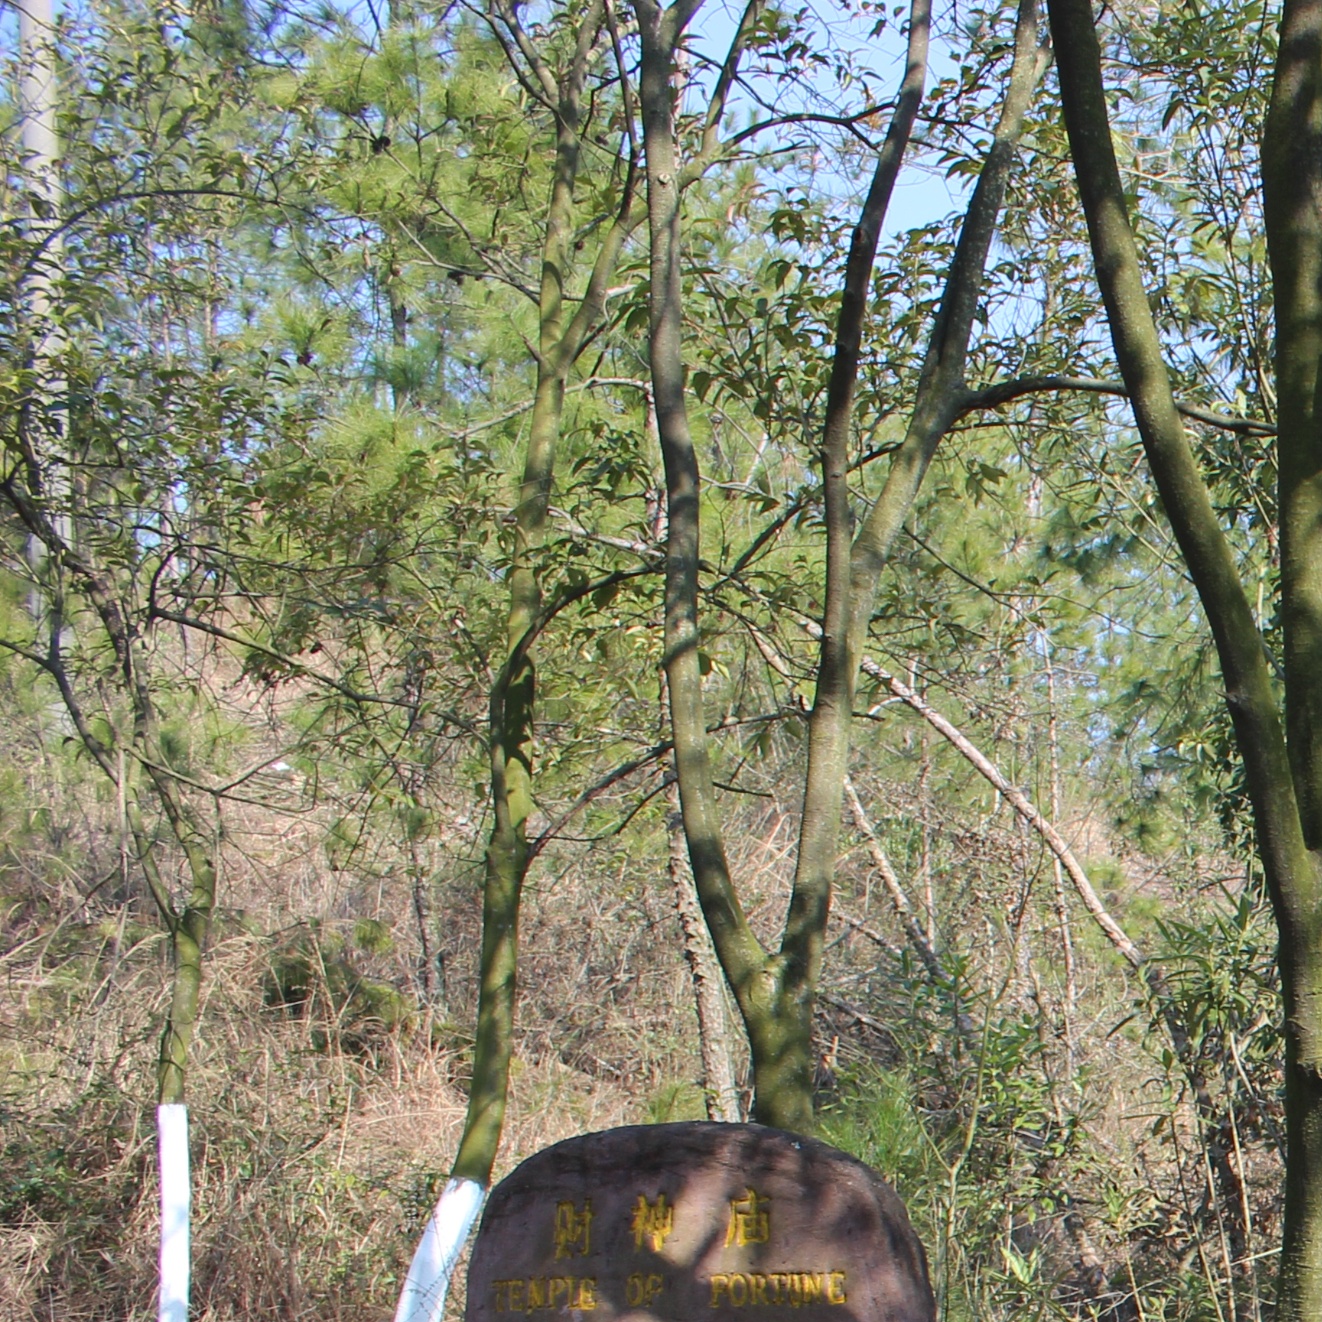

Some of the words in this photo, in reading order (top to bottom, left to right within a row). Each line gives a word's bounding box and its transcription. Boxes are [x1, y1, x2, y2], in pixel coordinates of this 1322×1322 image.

[493, 1276, 598, 1313] TEMPLE
[624, 1272, 663, 1308] OF
[710, 1270, 847, 1308] FORTUNE
